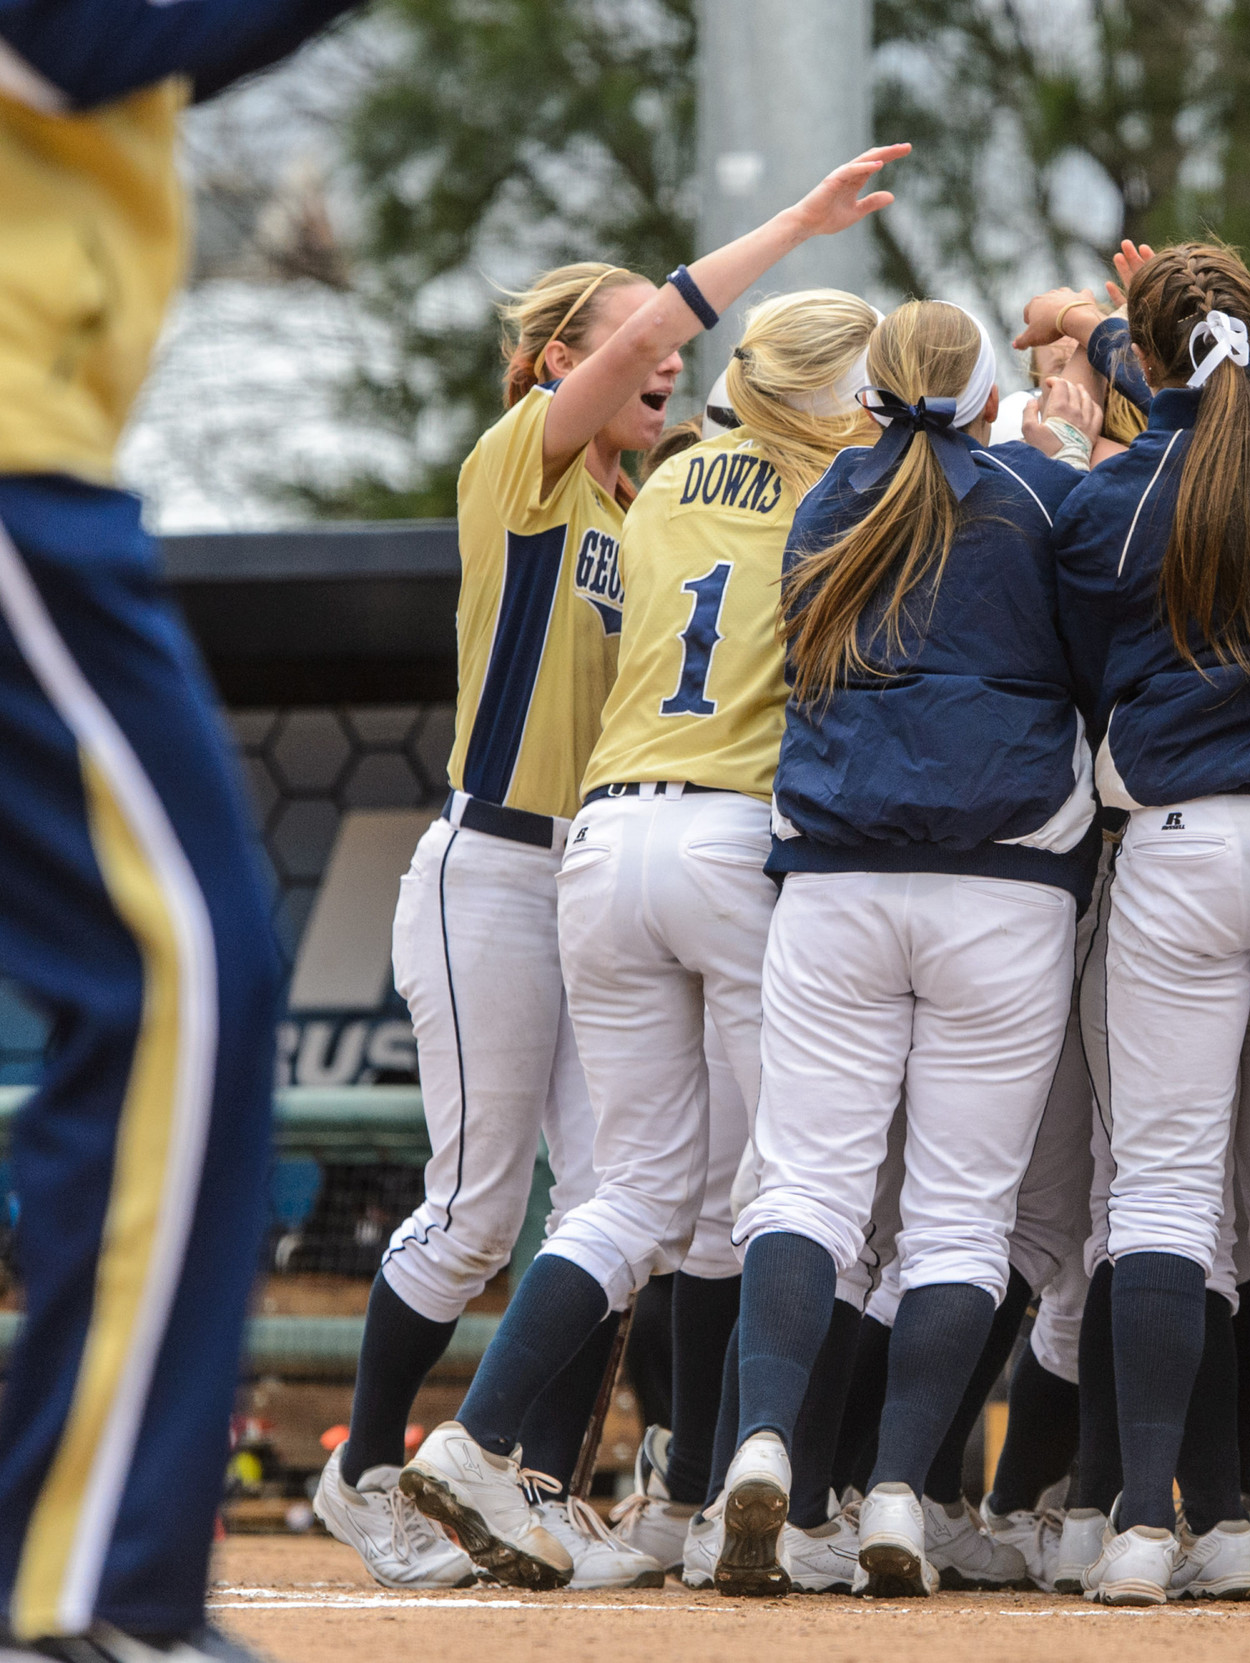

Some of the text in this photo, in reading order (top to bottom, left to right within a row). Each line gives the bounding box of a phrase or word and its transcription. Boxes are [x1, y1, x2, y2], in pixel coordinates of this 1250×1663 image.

[679, 453, 782, 514] DOWNS
[575, 527, 625, 606] GEO
[659, 560, 734, 717] 1
